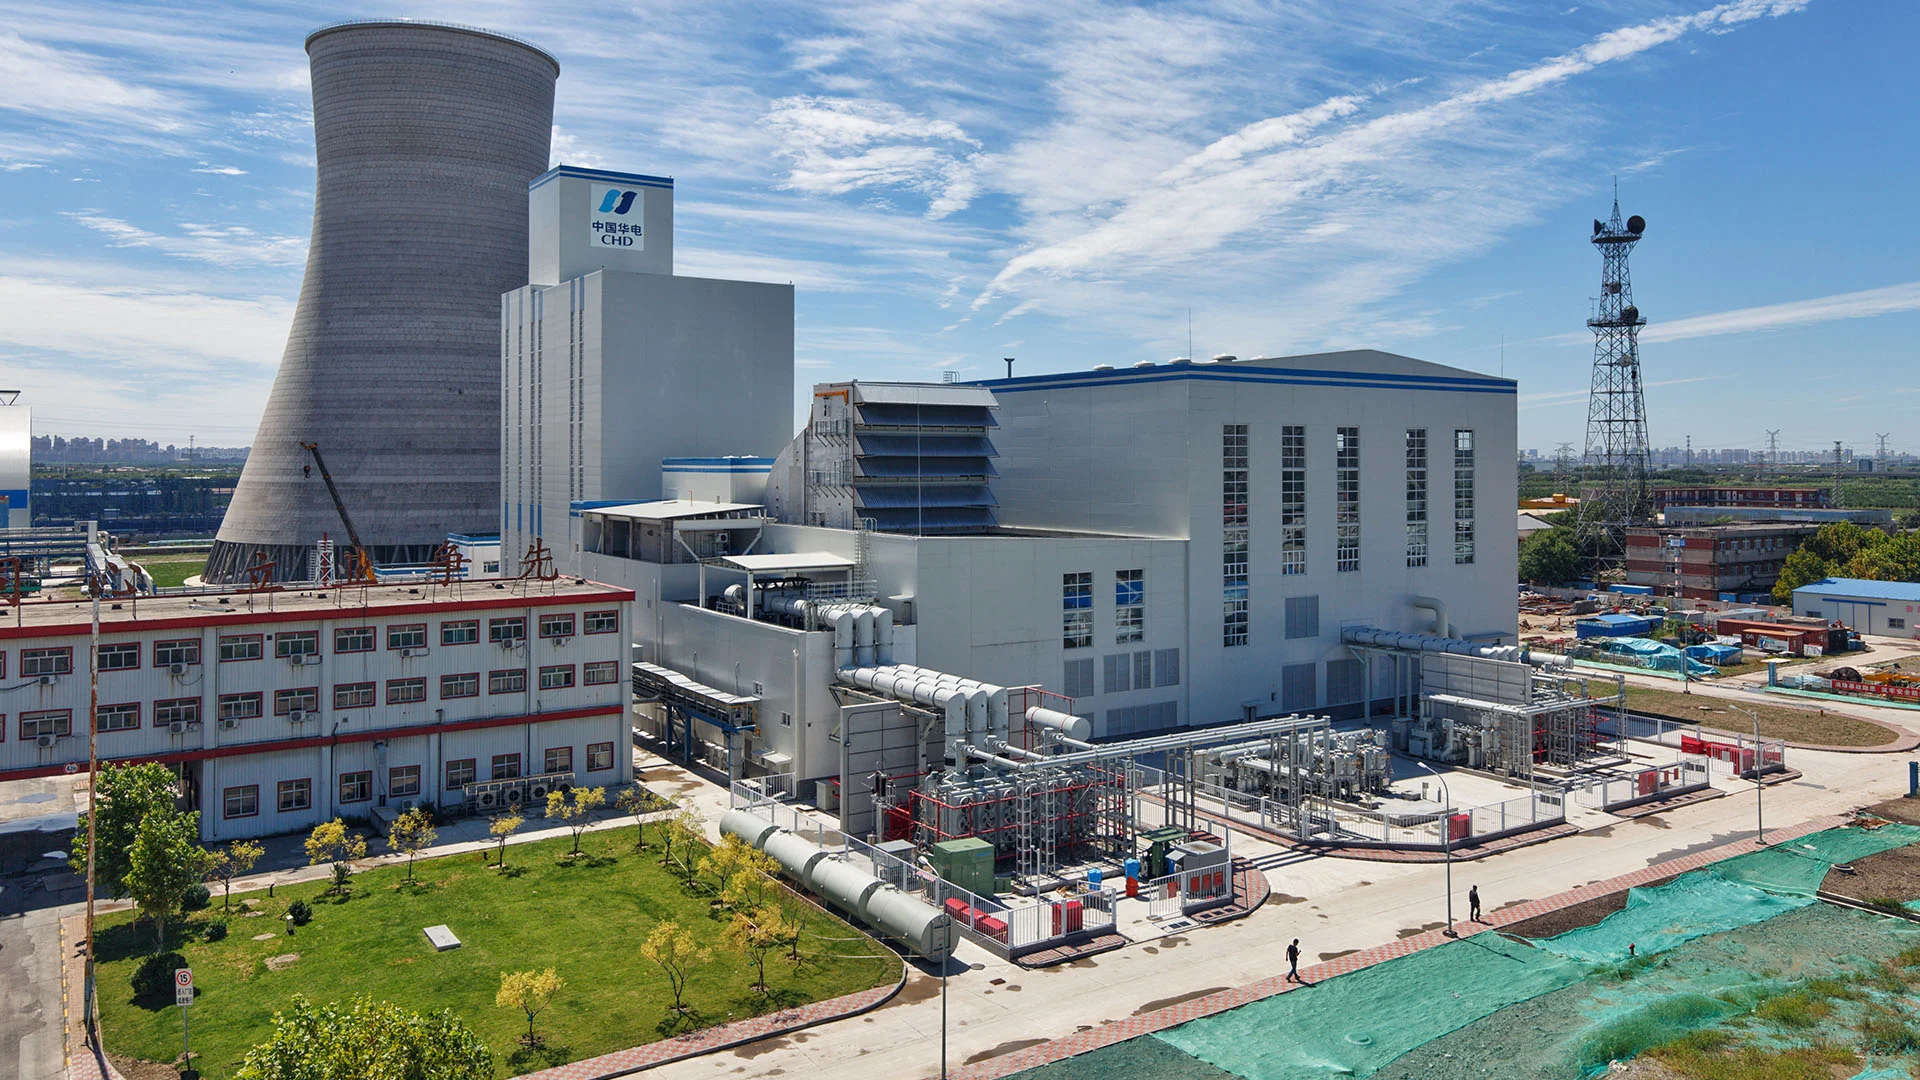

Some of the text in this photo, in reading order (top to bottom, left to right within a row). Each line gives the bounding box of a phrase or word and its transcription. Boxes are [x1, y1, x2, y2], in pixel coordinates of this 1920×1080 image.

[592, 220, 643, 236] 中国华电
[601, 234, 634, 246] CHD
[180, 974, 188, 983] 15
